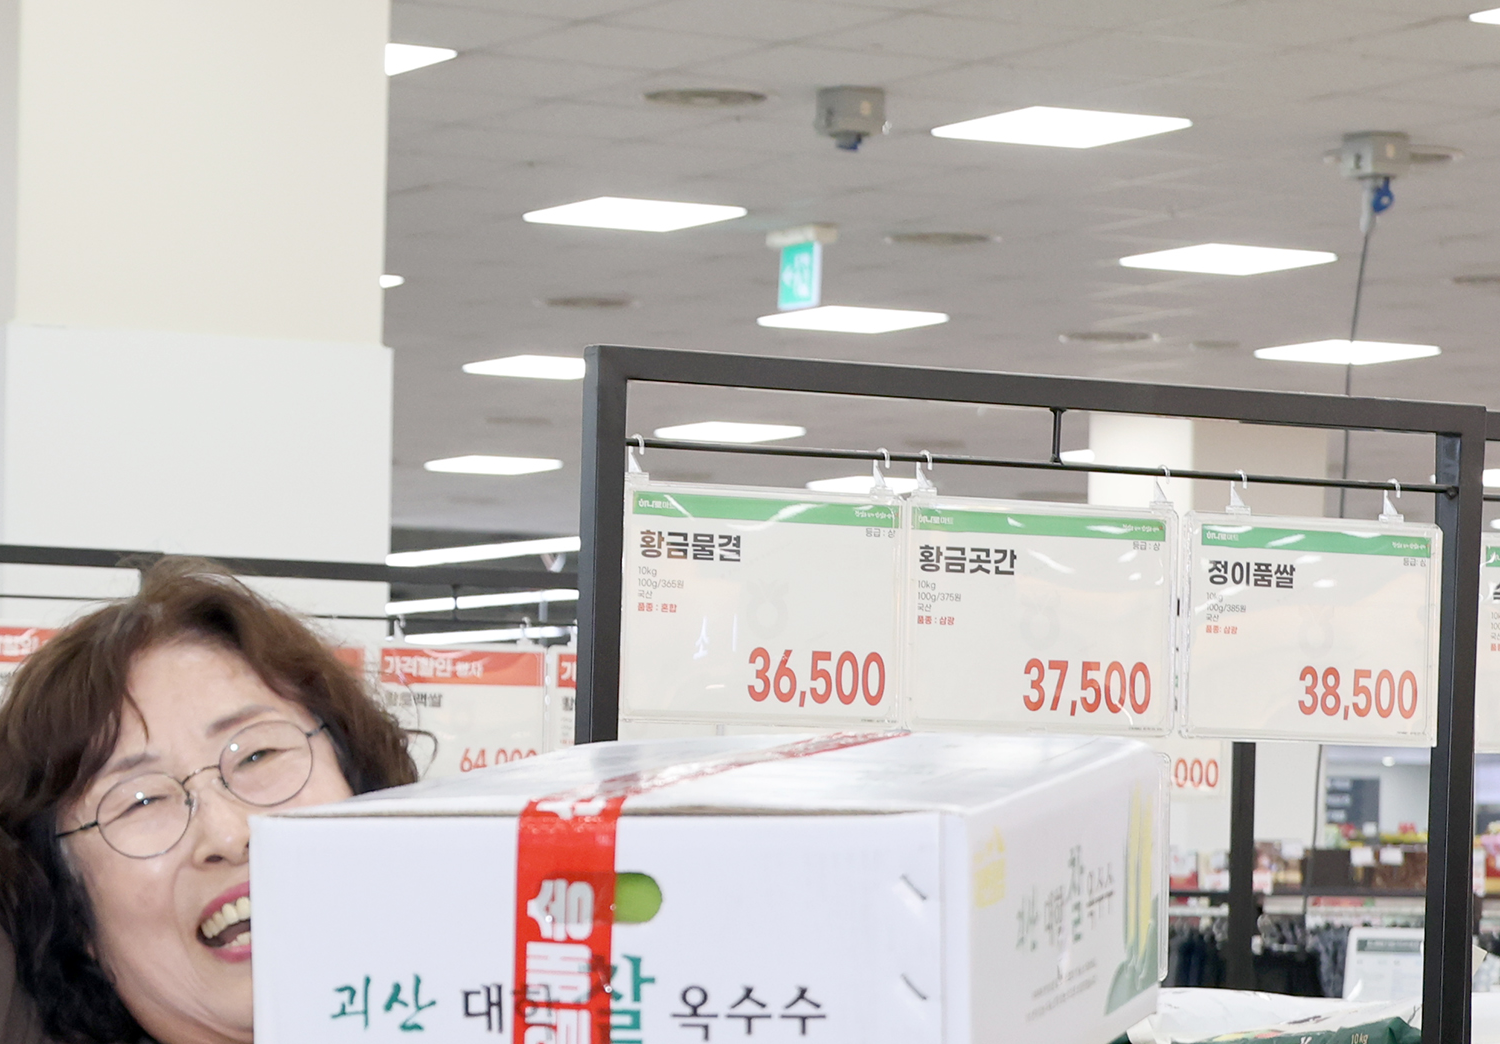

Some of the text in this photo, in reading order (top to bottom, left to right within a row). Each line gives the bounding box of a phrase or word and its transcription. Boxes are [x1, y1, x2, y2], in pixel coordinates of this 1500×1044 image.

[638, 566, 657, 577] 10kg
[919, 544, 1017, 575] 황금곳간
[1208, 560, 1296, 589] 정이품쌀
[918, 580, 936, 590] 10kg
[384, 655, 453, 678] 가격할인
[747, 646, 886, 707] 36,500
[1022, 657, 1152, 716] 37,500
[1298, 665, 1418, 721] 38,500
[331, 974, 436, 1031] 괴산
[670, 984, 827, 1041] 옥수수
[1351, 1033, 1369, 1044] 10kg
